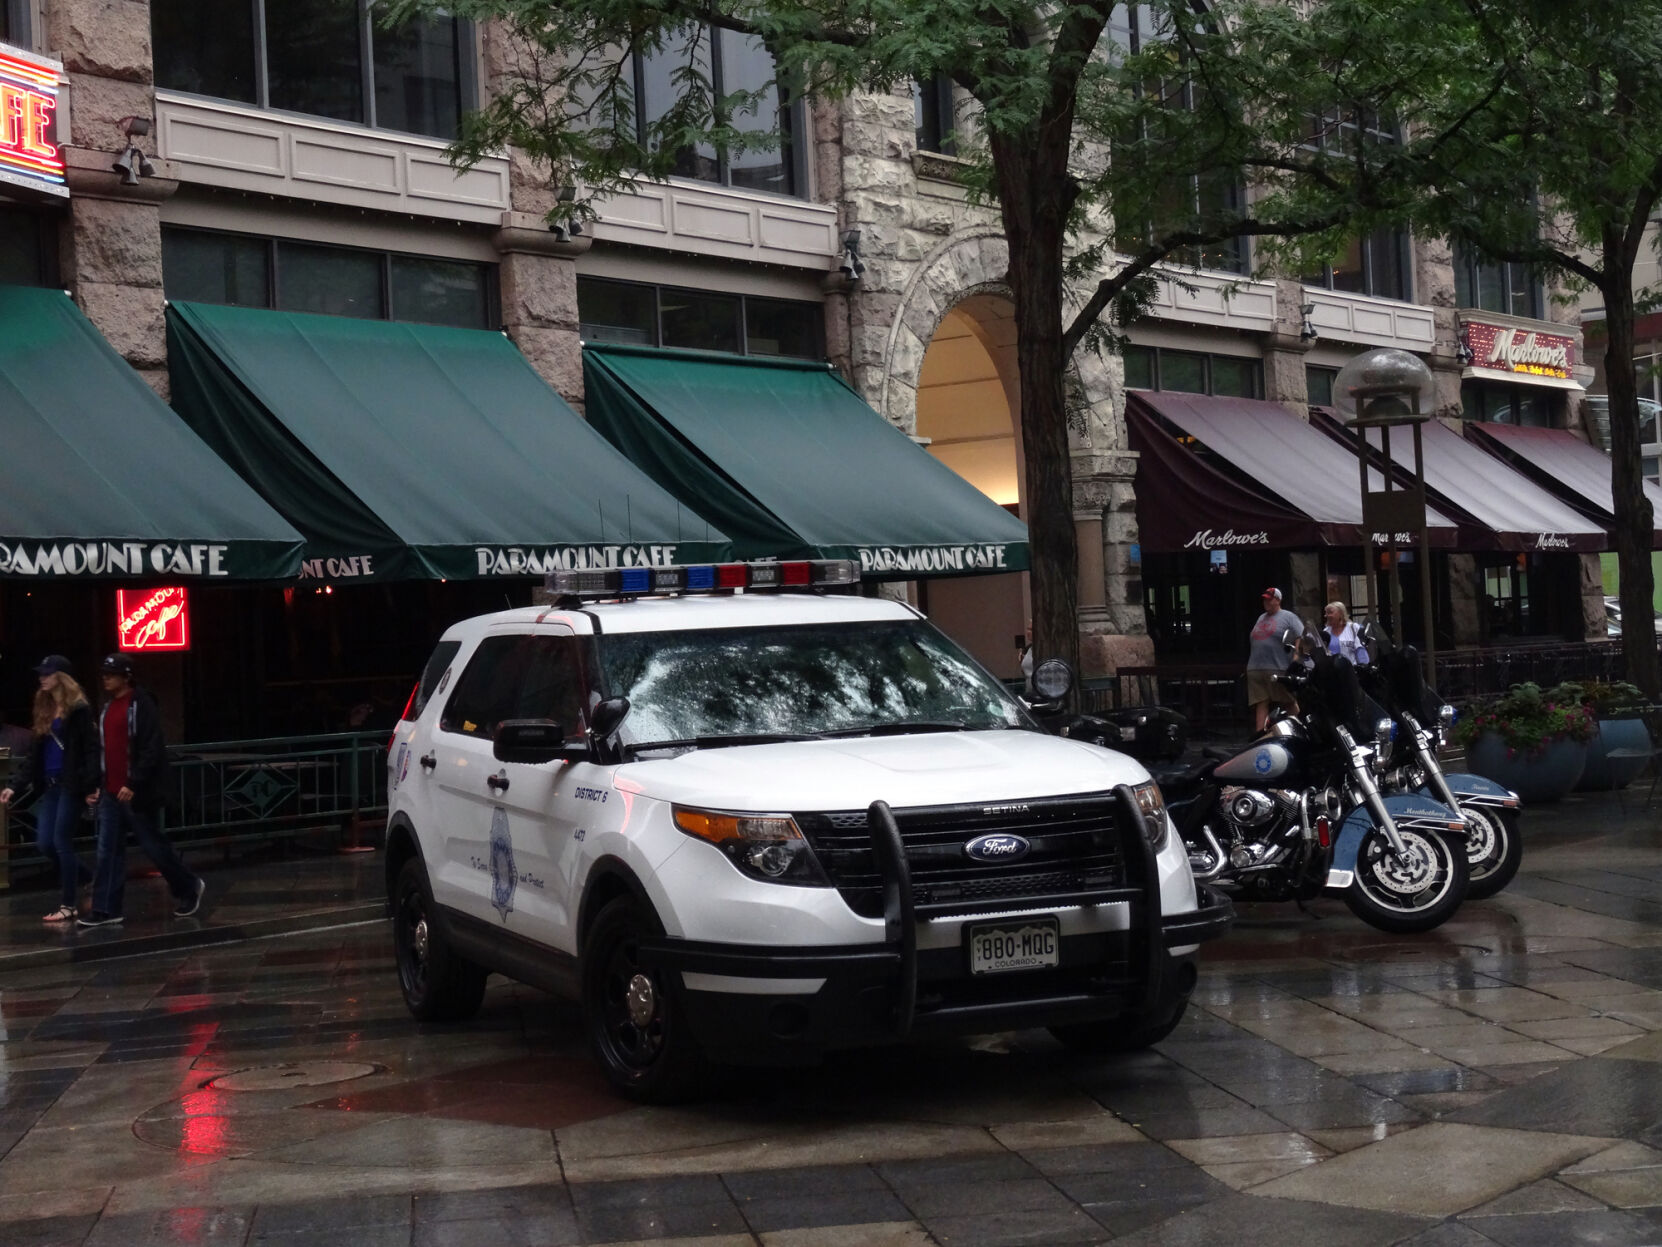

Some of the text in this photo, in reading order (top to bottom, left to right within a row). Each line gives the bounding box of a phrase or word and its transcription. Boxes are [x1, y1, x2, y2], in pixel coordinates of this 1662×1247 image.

[1486, 328, 1568, 370] Marlowe's
[1183, 529, 1270, 550] Marlowe's
[150, 543, 229, 576] CAFE
[326, 555, 375, 578] CAFE
[475, 545, 677, 575] PARAMOUNT CAFE
[858, 546, 1007, 572] PARAMOUNT CAFE
[574, 786, 609, 804] DISTRICT 6
[983, 804, 1030, 816] SETINA
[982, 838, 1017, 856] Ford
[994, 957, 1037, 969] COLORADO
